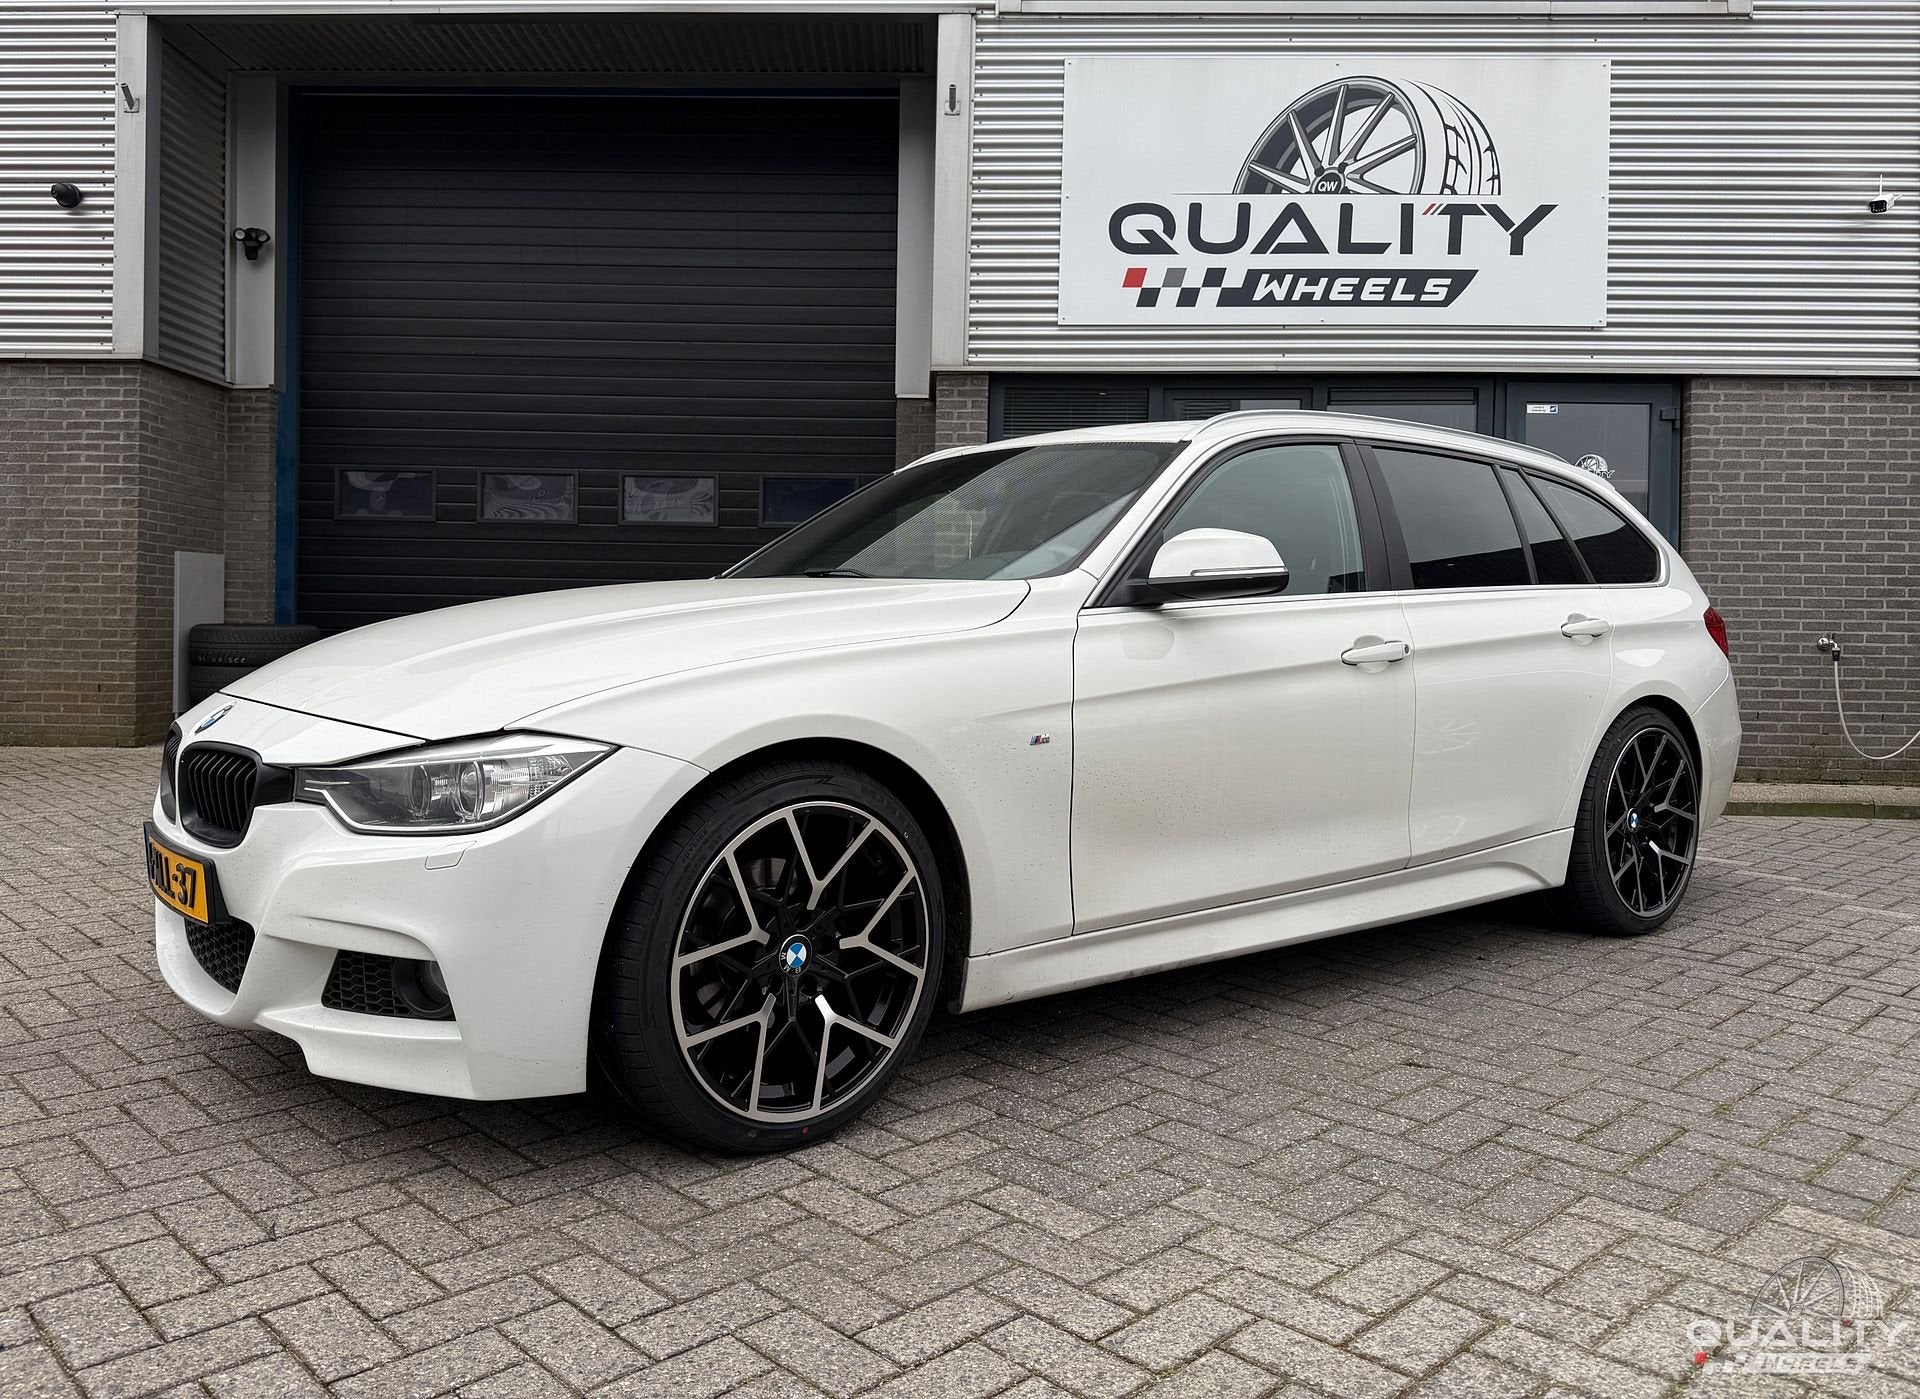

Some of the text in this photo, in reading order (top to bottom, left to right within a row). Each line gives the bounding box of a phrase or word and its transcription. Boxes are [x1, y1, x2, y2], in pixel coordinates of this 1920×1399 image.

[1318, 181, 1338, 192] QW
[1108, 201, 1559, 256] QUALITY
[1252, 273, 1453, 302] WHEELS
